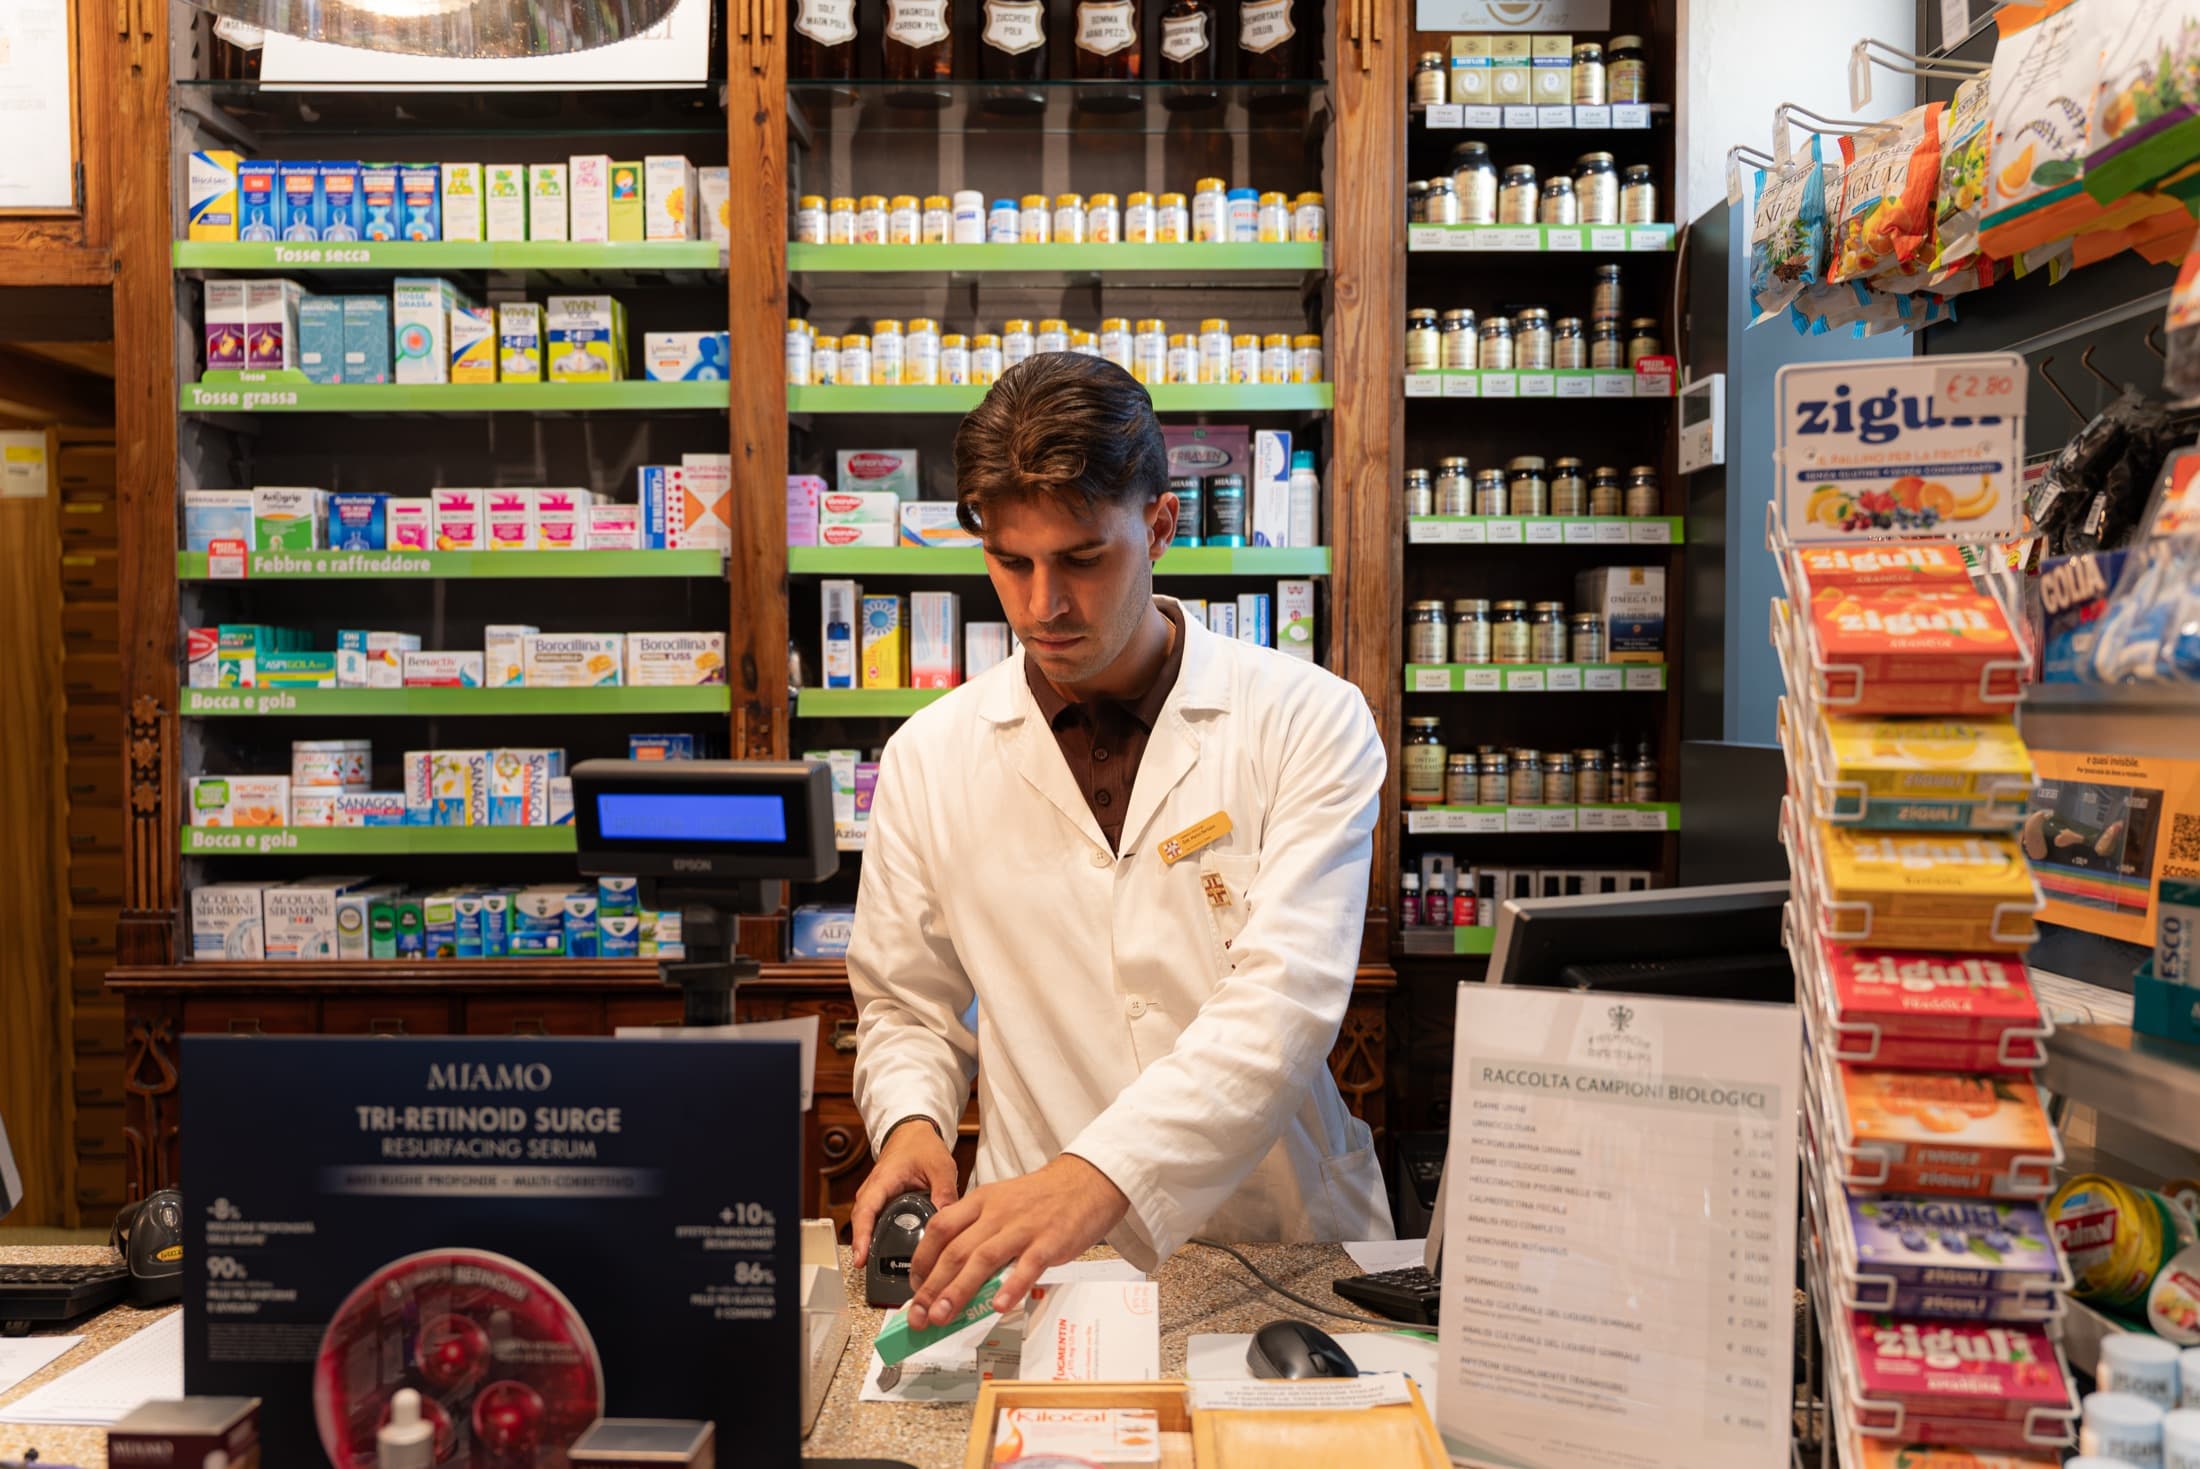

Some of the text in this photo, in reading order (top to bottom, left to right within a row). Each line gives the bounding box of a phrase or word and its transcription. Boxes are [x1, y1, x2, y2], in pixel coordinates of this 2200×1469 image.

[994, 13, 1032, 25] ZUCCHERO
[273, 246, 371, 263] Tosse secca
[561, 301, 598, 312] VIVIN
[239, 370, 266, 382] Tosse
[192, 388, 298, 410] Tosse grassa
[1796, 383, 2003, 445] zigu
[253, 555, 432, 573] Febbre e raffreddore
[2040, 553, 2108, 615] GOLIA
[535, 639, 600, 652] Borocillina
[640, 638, 706, 651] Borocillina
[407, 655, 457, 668] Benactiv
[190, 692, 297, 713] Bocca e gola
[468, 756, 486, 825] SANAGO
[336, 797, 400, 810] SANAGOL
[192, 831, 298, 852] Bocca e gola
[673, 859, 713, 871] EPSON
[426, 1062, 553, 1092] MIAMO
[1482, 1067, 1767, 1110] RACCOLTA CAMPIONI BIOLOGICI
[355, 1105, 623, 1134] TRI-RETINOID SURGE
[380, 1137, 599, 1160] RESURFACING SERUM
[734, 1260, 777, 1286] 86%
[1015, 1410, 1108, 1424] Kilocal
